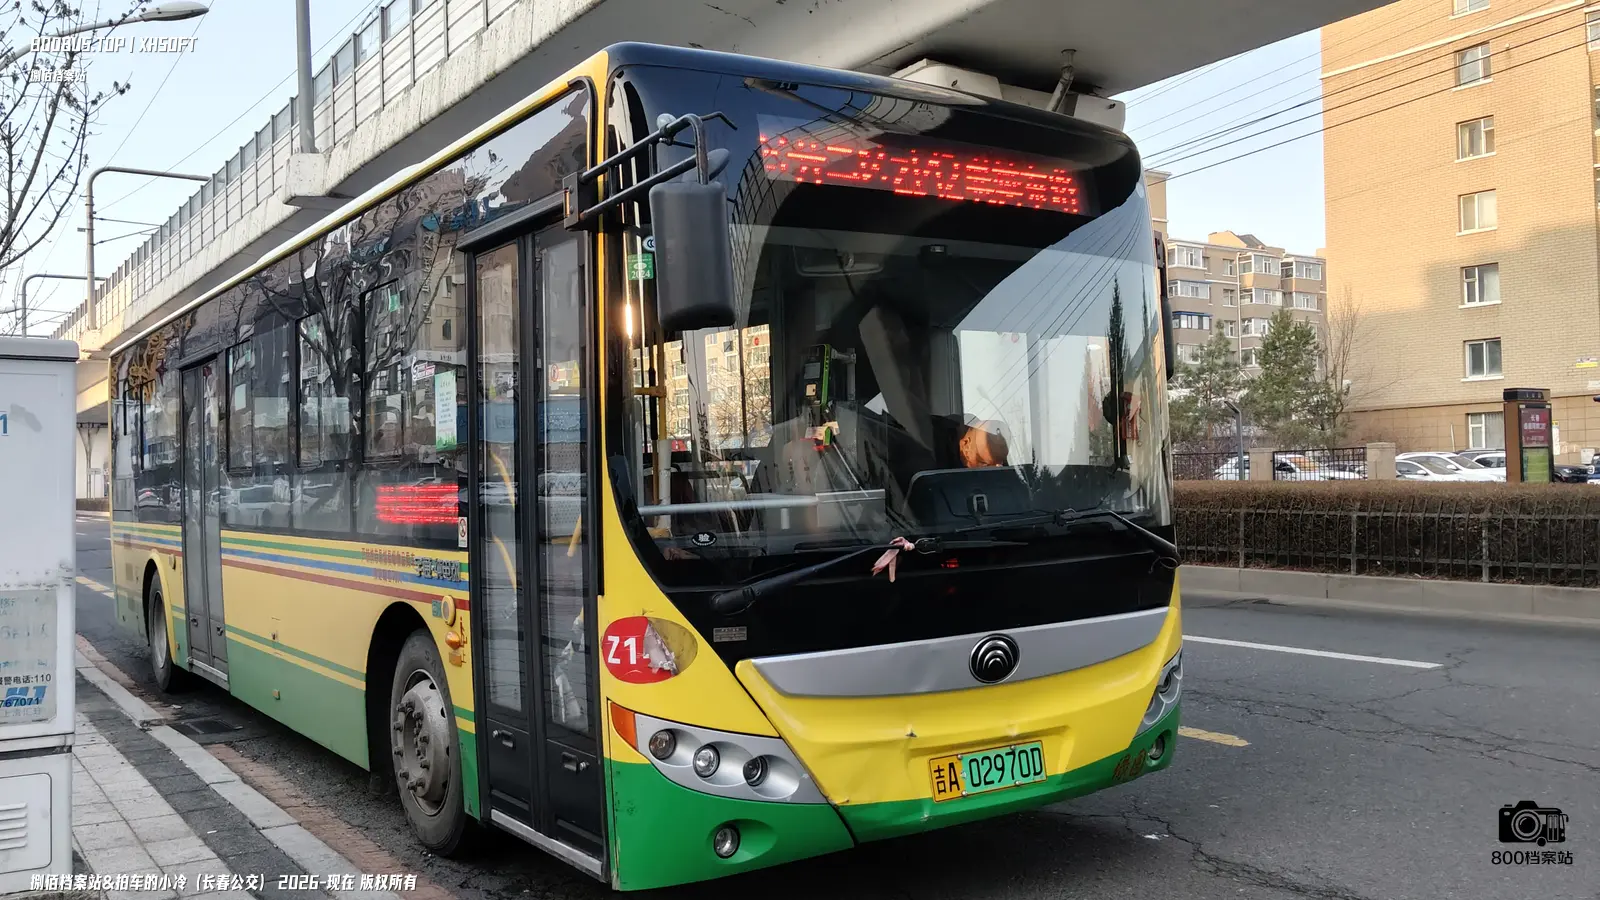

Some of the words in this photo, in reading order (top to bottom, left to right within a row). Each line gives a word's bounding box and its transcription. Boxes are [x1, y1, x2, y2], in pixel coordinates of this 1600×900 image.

[631, 270, 651, 279] 2024
[698, 533, 710, 542] 验
[607, 635, 649, 665] Z1
[968, 746, 1044, 788] 02970D
